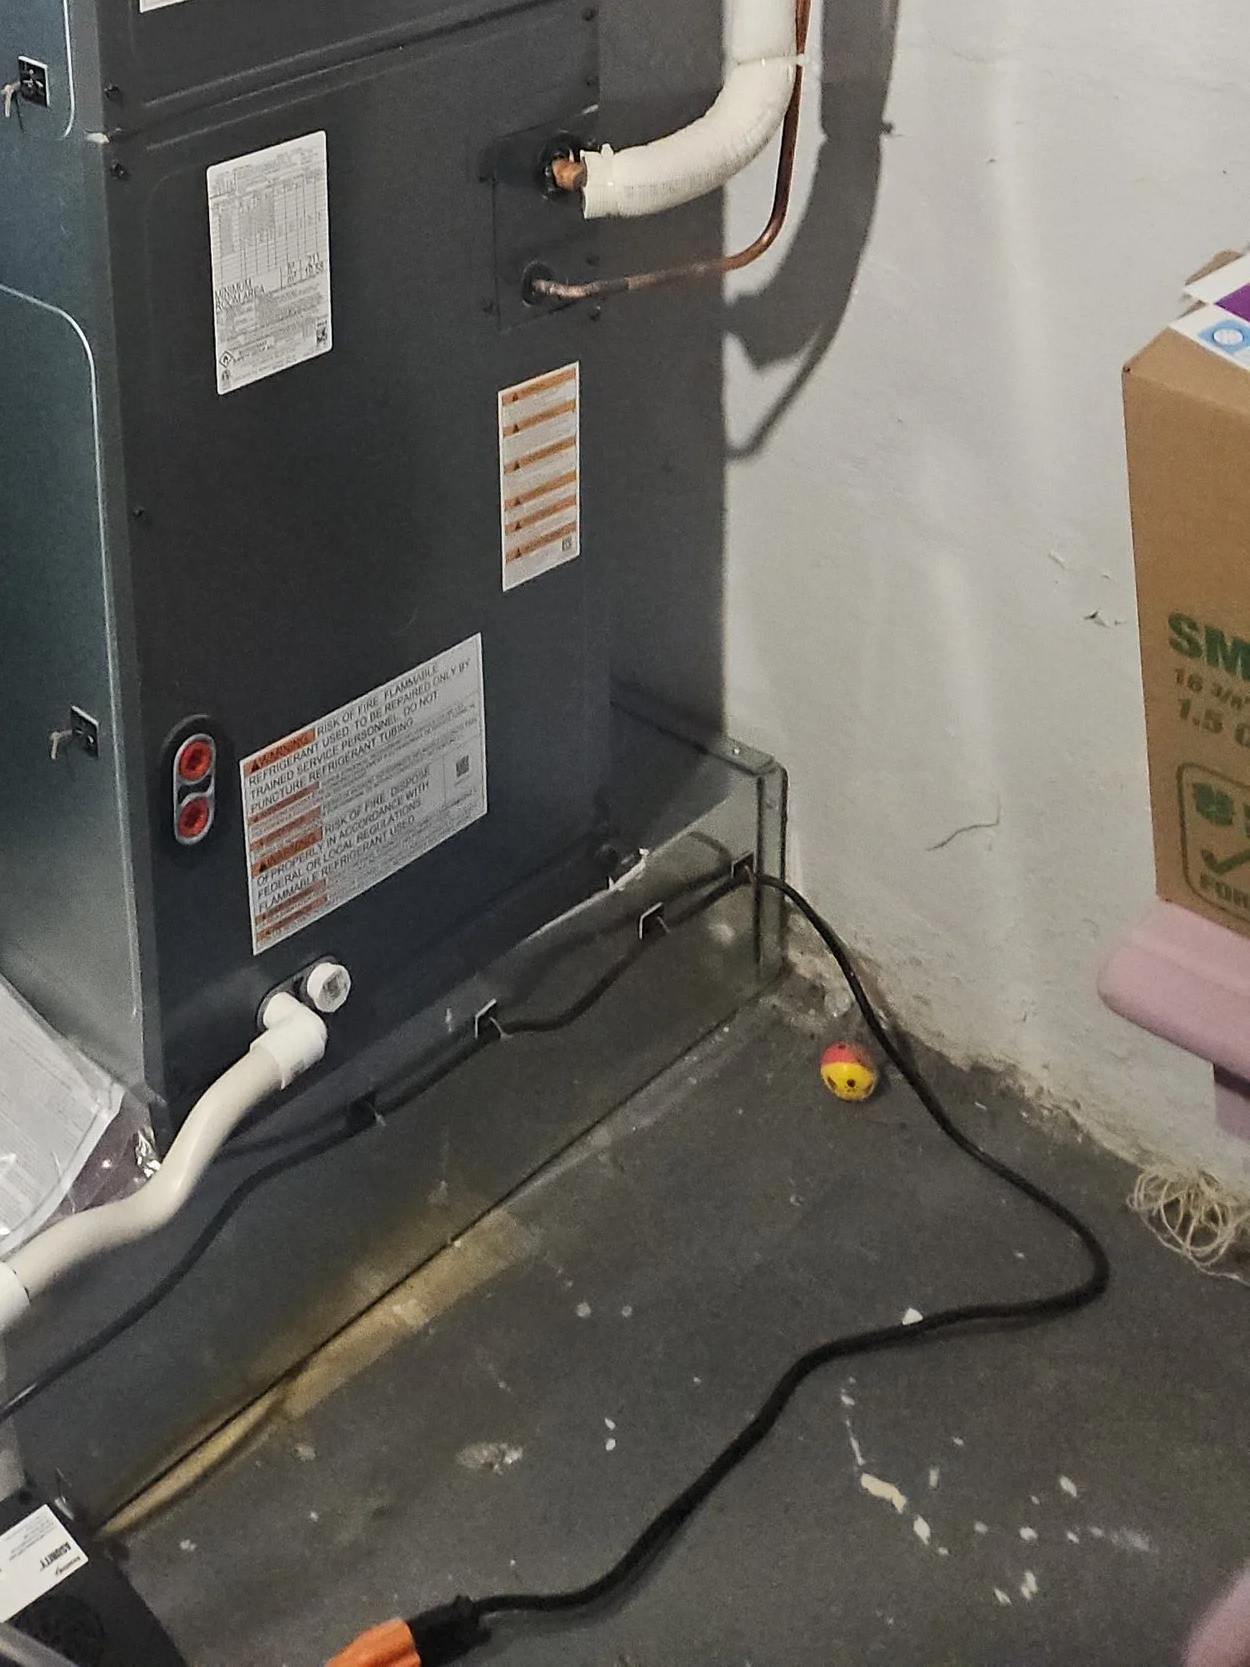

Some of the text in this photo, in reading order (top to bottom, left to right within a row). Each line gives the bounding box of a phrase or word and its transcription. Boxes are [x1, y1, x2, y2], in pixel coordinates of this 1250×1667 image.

[249, 740, 318, 788] REFRIGERANT
[354, 714, 367, 730] TO
[370, 706, 381, 722] BE
[384, 679, 430, 714] REPAIRED
[432, 665, 456, 687] ONLY
[317, 715, 339, 737] RISK
[342, 707, 352, 723] OF
[384, 662, 436, 701] FLAMMABLE
[1180, 697, 1223, 734] 1.5
[250, 768, 293, 801] TRAINED
[296, 743, 338, 776] SERVICE
[403, 700, 417, 717] DO
[419, 689, 437, 708] NOT
[251, 776, 304, 815] PUNCTURE
[308, 736, 376, 783] REFRIGERANT
[270, 841, 322, 881] PROPERLY
[326, 833, 335, 848] IN
[339, 796, 400, 840] ACCORDANCE
[405, 779, 429, 802] WITH
[325, 812, 346, 835] RISK
[349, 805, 359, 821] OF
[257, 865, 302, 901] FEDERAL
[306, 855, 320, 873] OR
[323, 837, 351, 863] LOCAL
[258, 872, 316, 915] FLAMMABLE
[321, 830, 386, 878] REFRIGERANT
